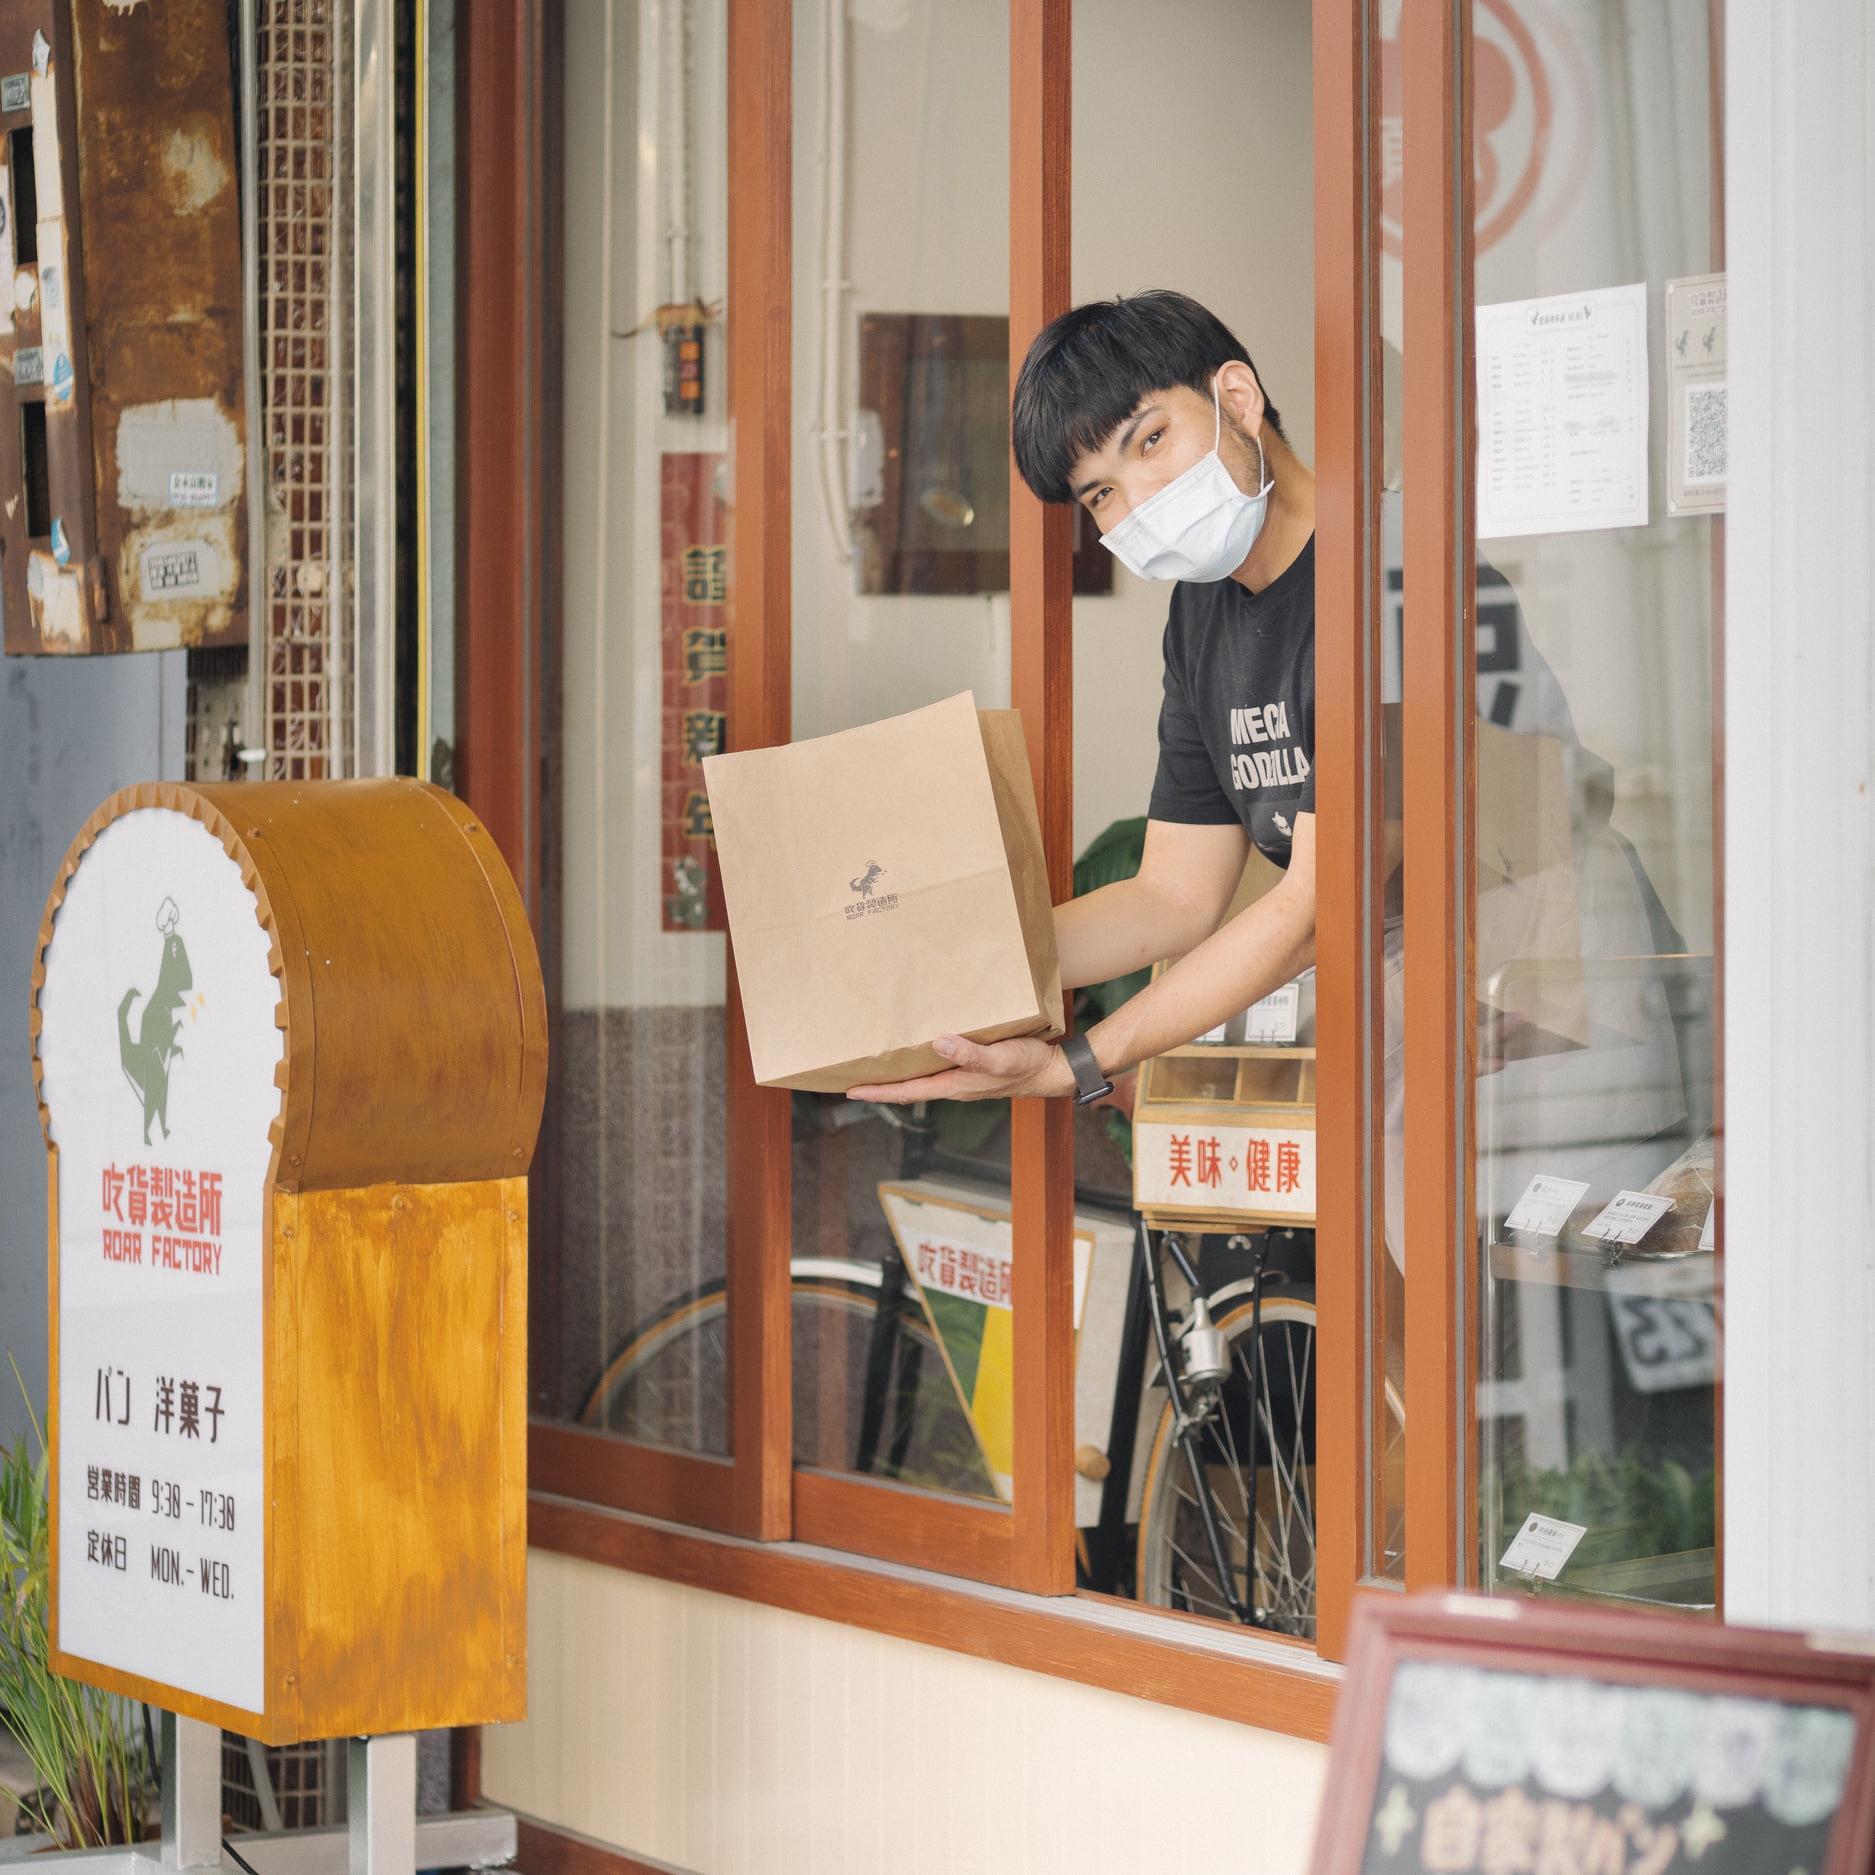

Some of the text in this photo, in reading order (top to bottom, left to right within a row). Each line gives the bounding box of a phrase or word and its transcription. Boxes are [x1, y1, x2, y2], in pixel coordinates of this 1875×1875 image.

[844, 893, 898, 913] 吃貨製造所
[867, 903, 899, 915] FACTORY
[1169, 1133, 1301, 1193] 美味 健康
[102, 1161, 223, 1236] 吃貨製造所
[102, 1228, 222, 1276] ROAR FACTORY
[96, 1366, 225, 1443] パン 洋菓子
[87, 1464, 141, 1510] 営業時間
[87, 1529, 127, 1572] 定休日
